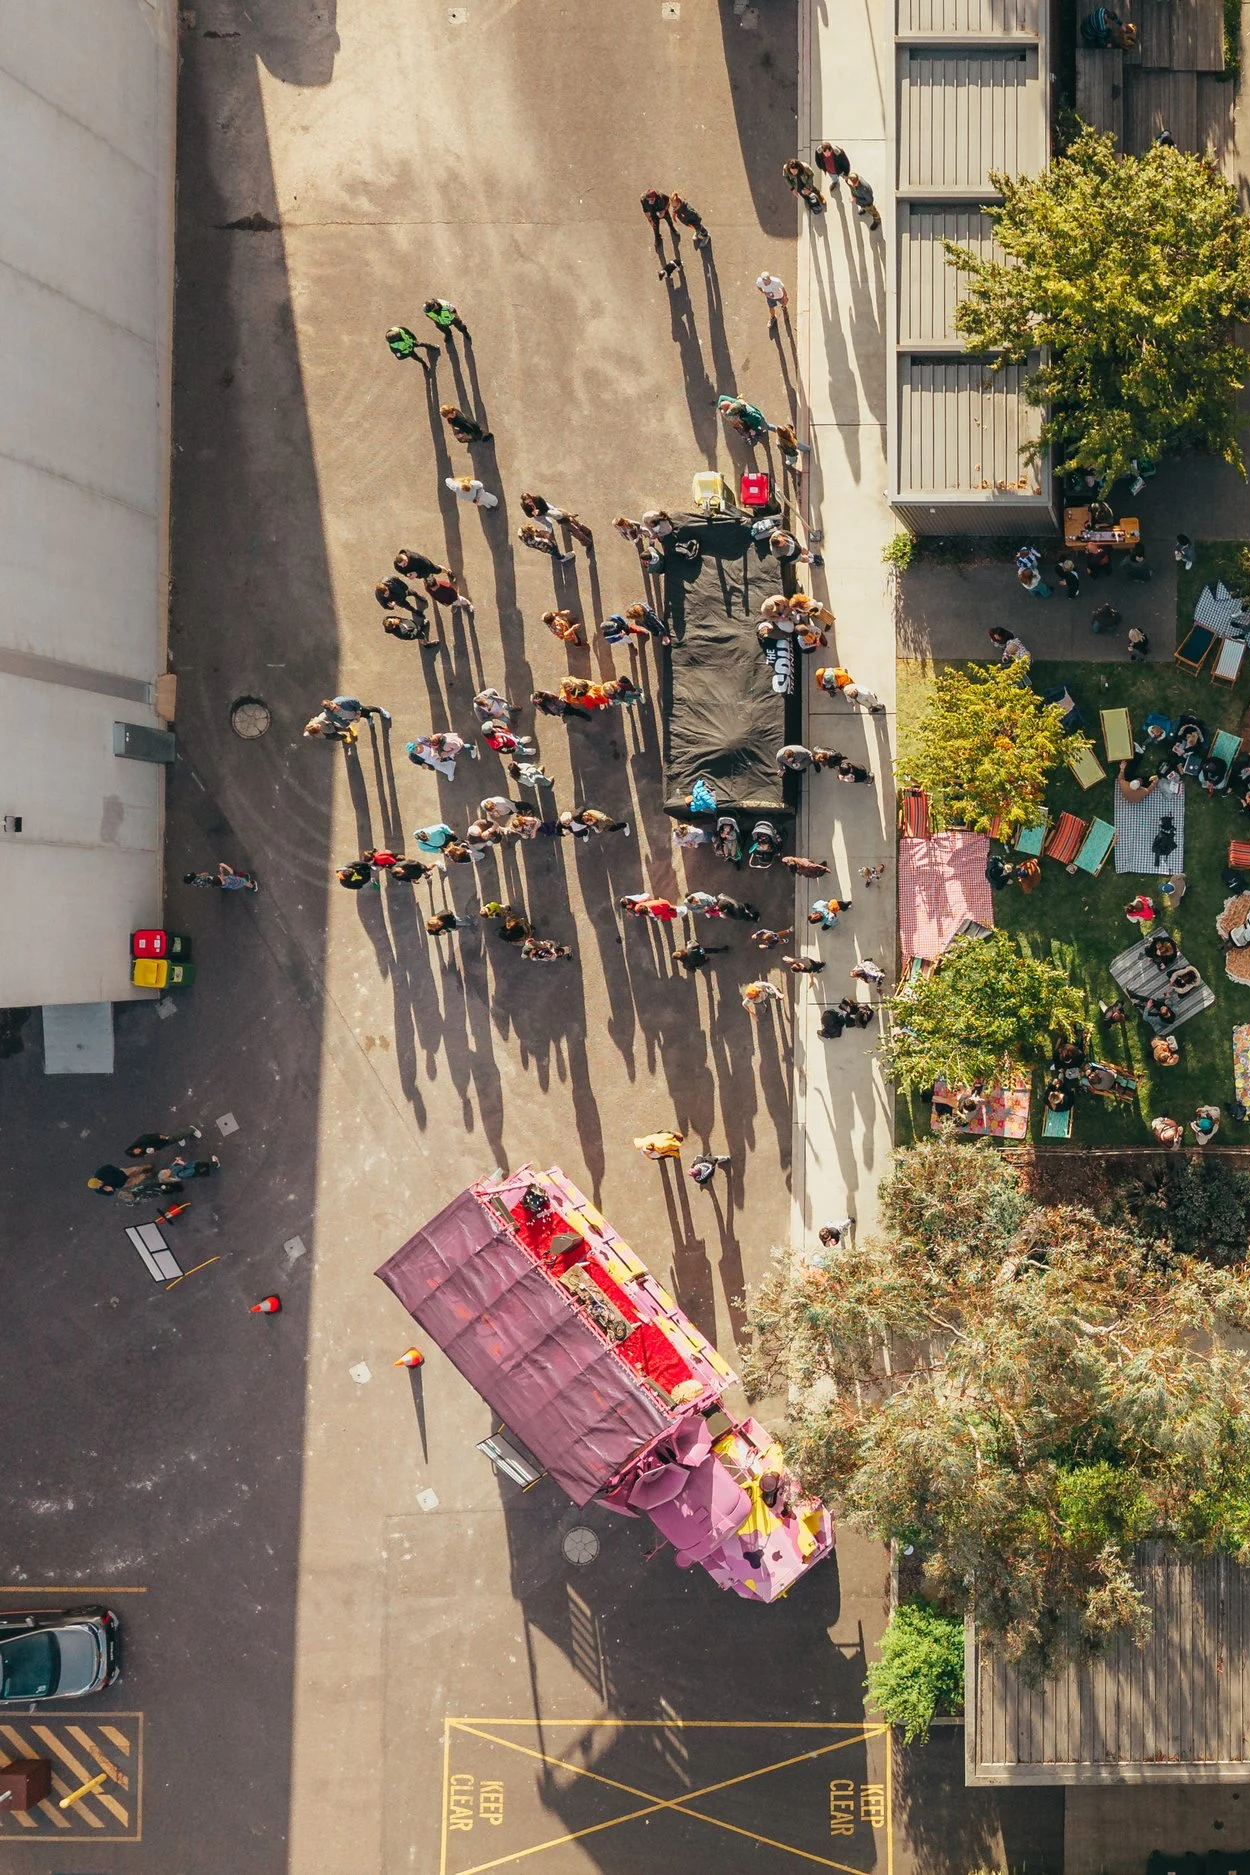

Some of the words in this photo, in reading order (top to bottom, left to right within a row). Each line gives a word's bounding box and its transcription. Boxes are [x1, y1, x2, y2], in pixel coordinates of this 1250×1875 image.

[766, 648, 776, 665] THE
[449, 1774, 475, 1831] CLEAR
[480, 1781, 504, 1826] KEEP
[830, 1779, 855, 1836] CLEAR
[861, 1784, 885, 1828] KEEP
